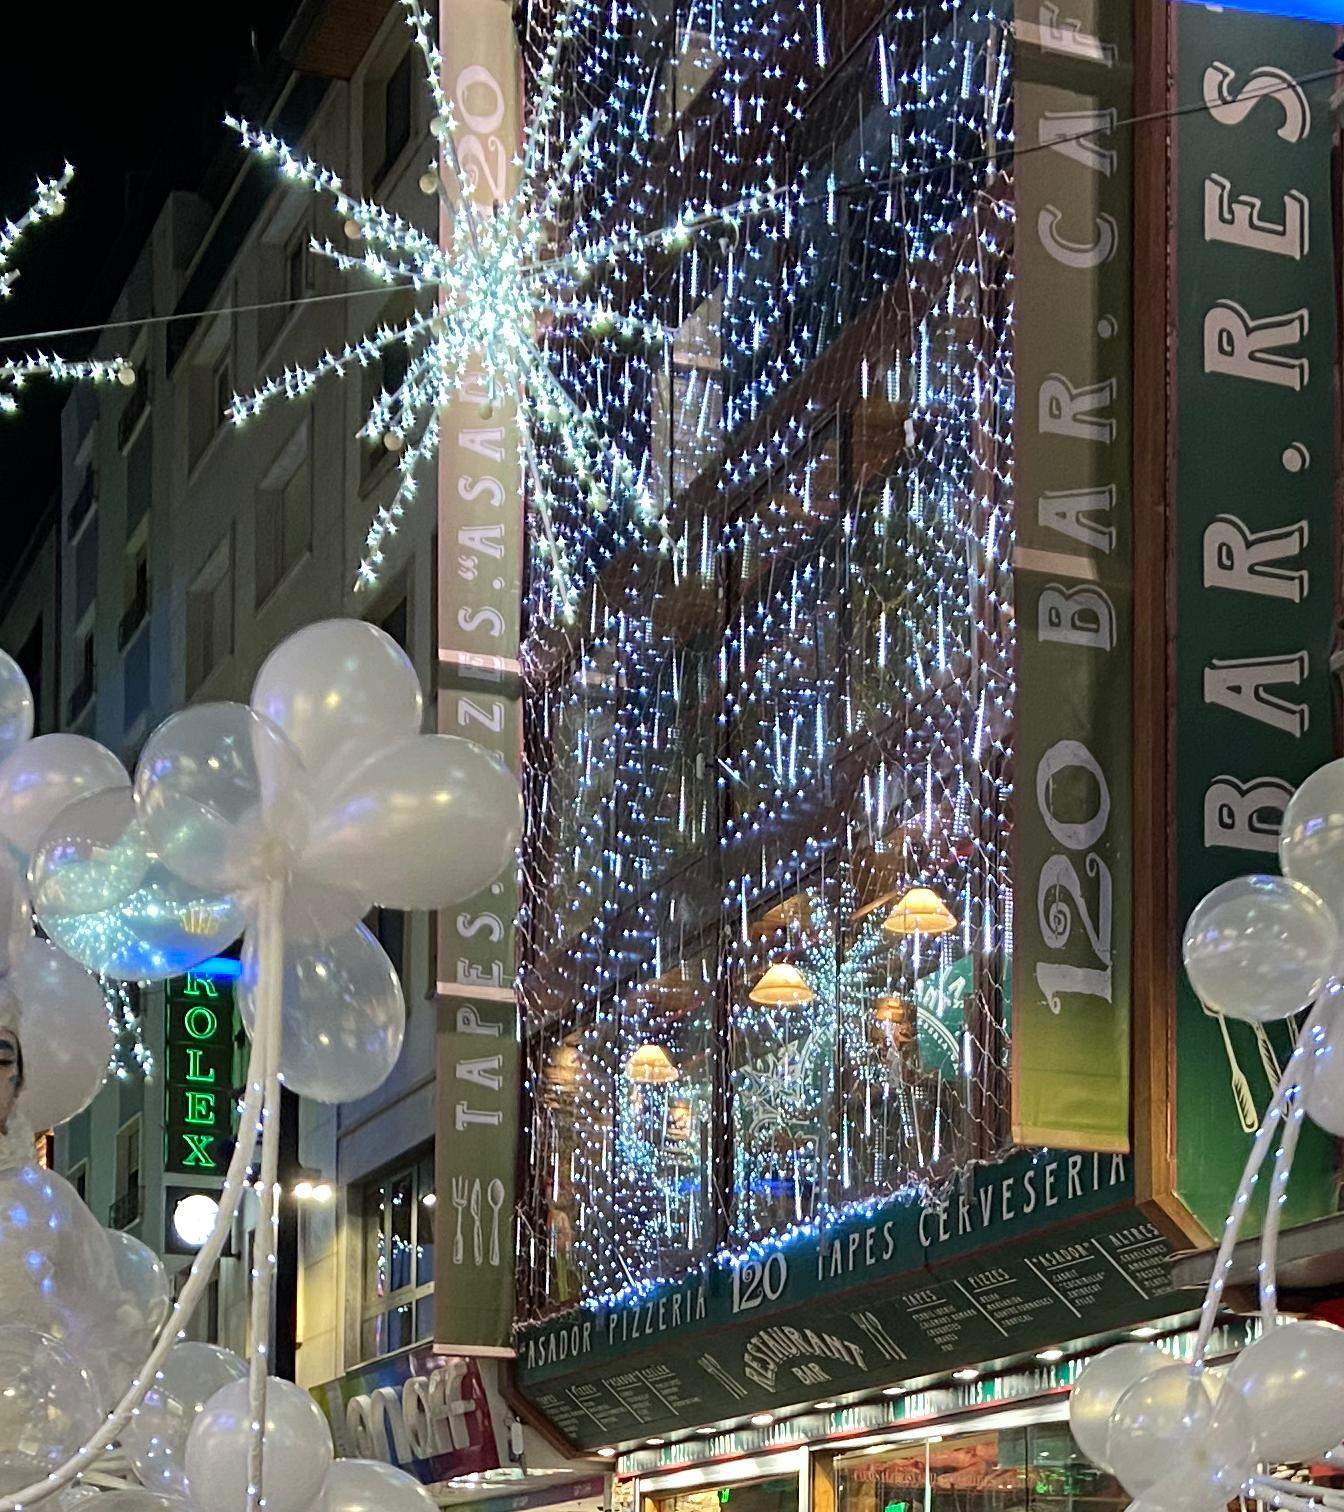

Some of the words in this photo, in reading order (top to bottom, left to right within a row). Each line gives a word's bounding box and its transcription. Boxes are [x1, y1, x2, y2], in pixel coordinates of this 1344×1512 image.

[1034, 739, 1114, 1014] 120
[608, 1287, 707, 1346] PIZZERIA
[729, 1251, 788, 1314] 120
[918, 1151, 1126, 1248] CERVESERIA
[1107, 1222, 1160, 1248] ALTRES
[967, 1267, 1011, 1290] PIZZES
[743, 1325, 869, 1393] RESTAURANT
[790, 1362, 832, 1386] BAR
